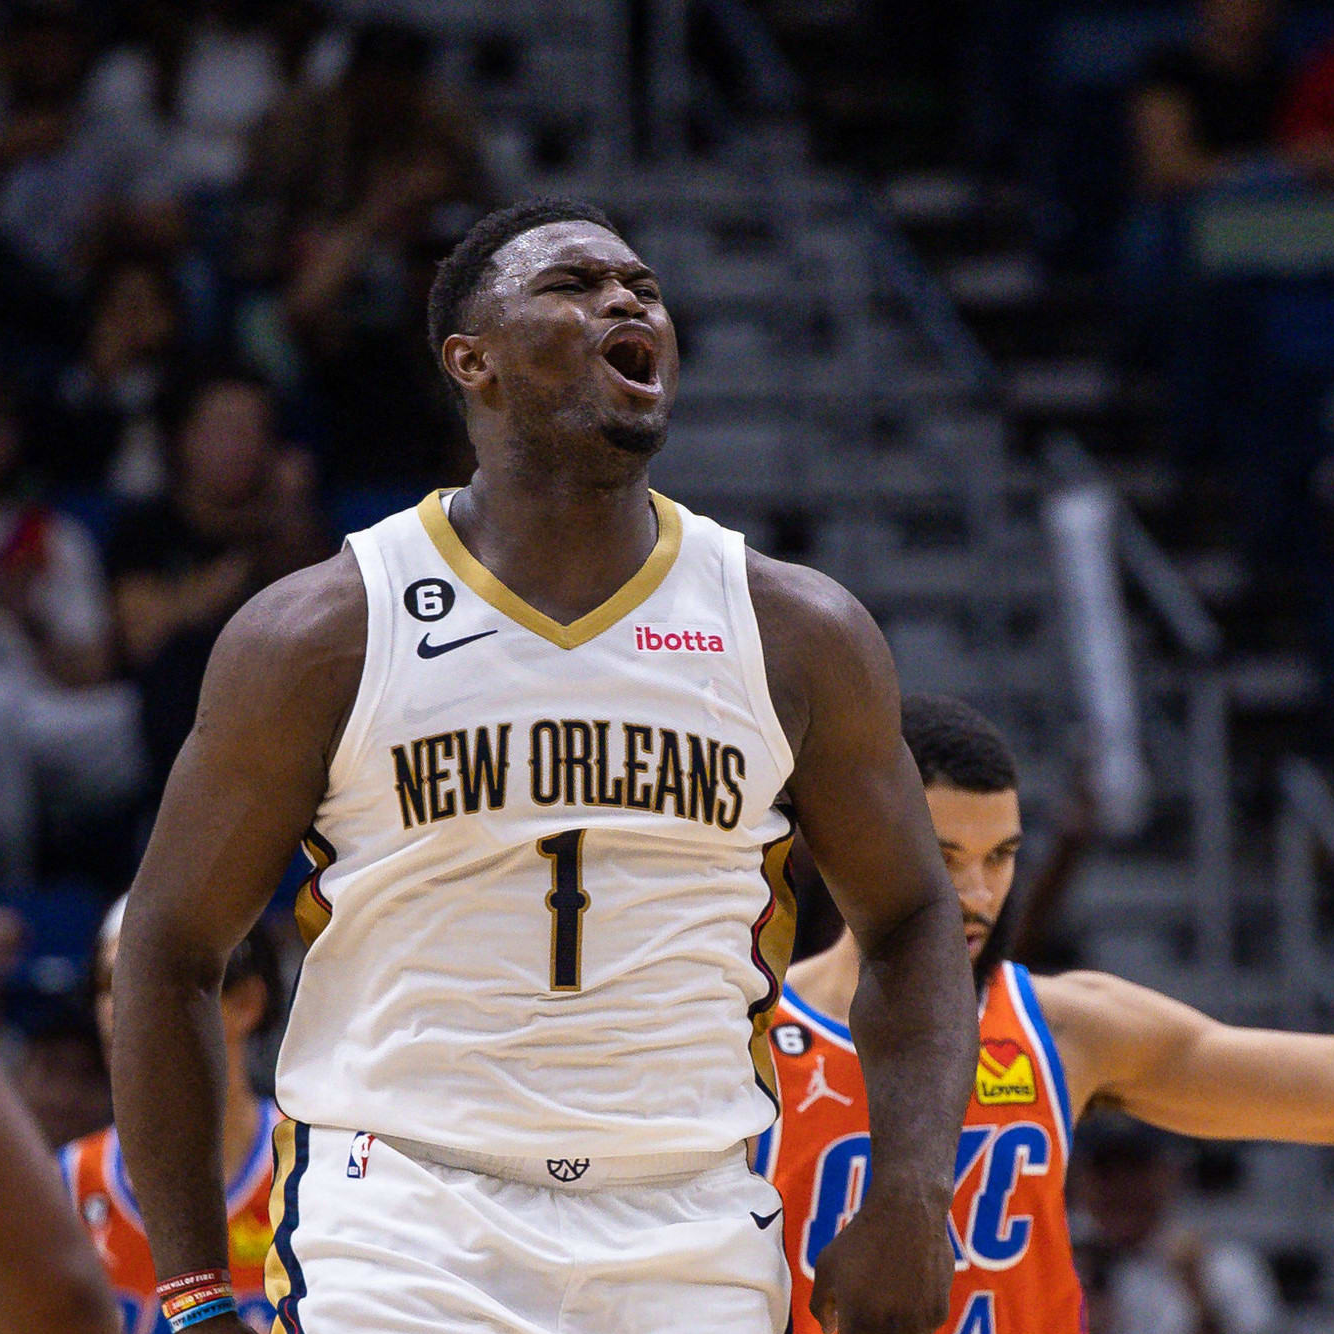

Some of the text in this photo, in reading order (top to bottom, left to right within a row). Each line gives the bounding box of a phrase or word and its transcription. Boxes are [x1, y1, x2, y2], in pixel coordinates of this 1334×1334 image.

[415, 584, 444, 617] 6
[634, 626, 725, 653] ibotta
[391, 718, 747, 832] NEW ORLEANS
[536, 827, 591, 992] 1
[775, 1026, 805, 1053] 6
